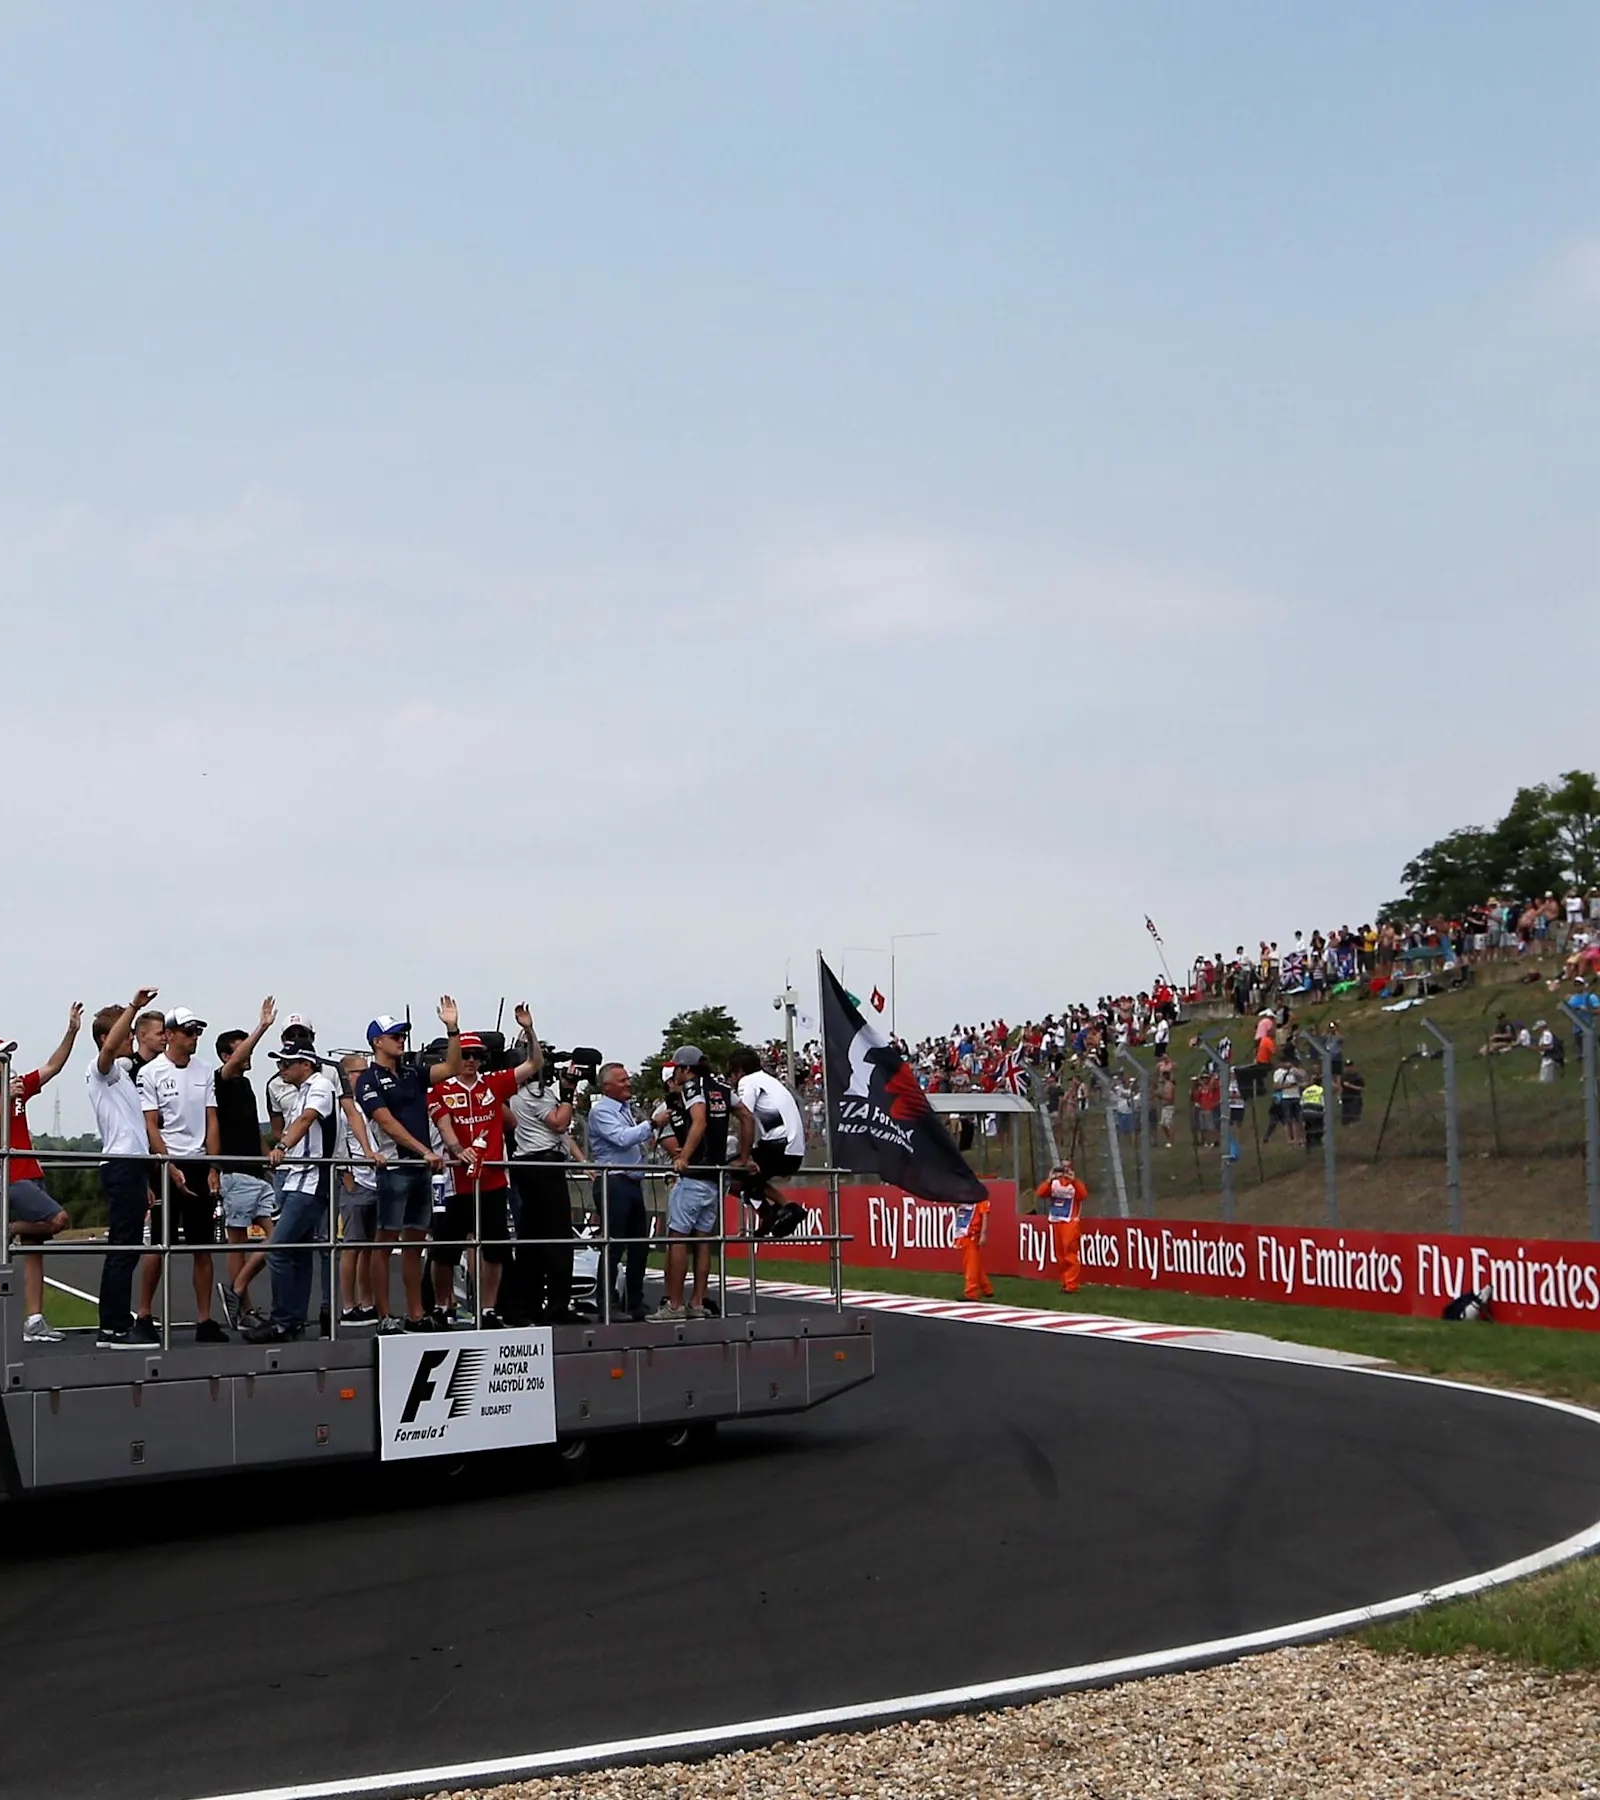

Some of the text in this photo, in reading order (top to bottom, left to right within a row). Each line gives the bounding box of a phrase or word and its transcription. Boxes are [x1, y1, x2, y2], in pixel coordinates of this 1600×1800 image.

[868, 1196, 899, 1260] Fly
[902, 1196, 956, 1249] Emira
[1019, 1222, 1047, 1272] Fly
[1126, 1227, 1247, 1280] Fly Emirates
[1257, 1235, 1404, 1295] Fly Emirates
[1417, 1243, 1600, 1311] Fly Emirates
[499, 1343, 545, 1359] FORMULA 1
[493, 1361, 529, 1376] MAGYAR
[526, 1376, 545, 1391] 2016
[480, 1404, 512, 1417] BUDAPEST
[394, 1424, 447, 1442] Formula 1
